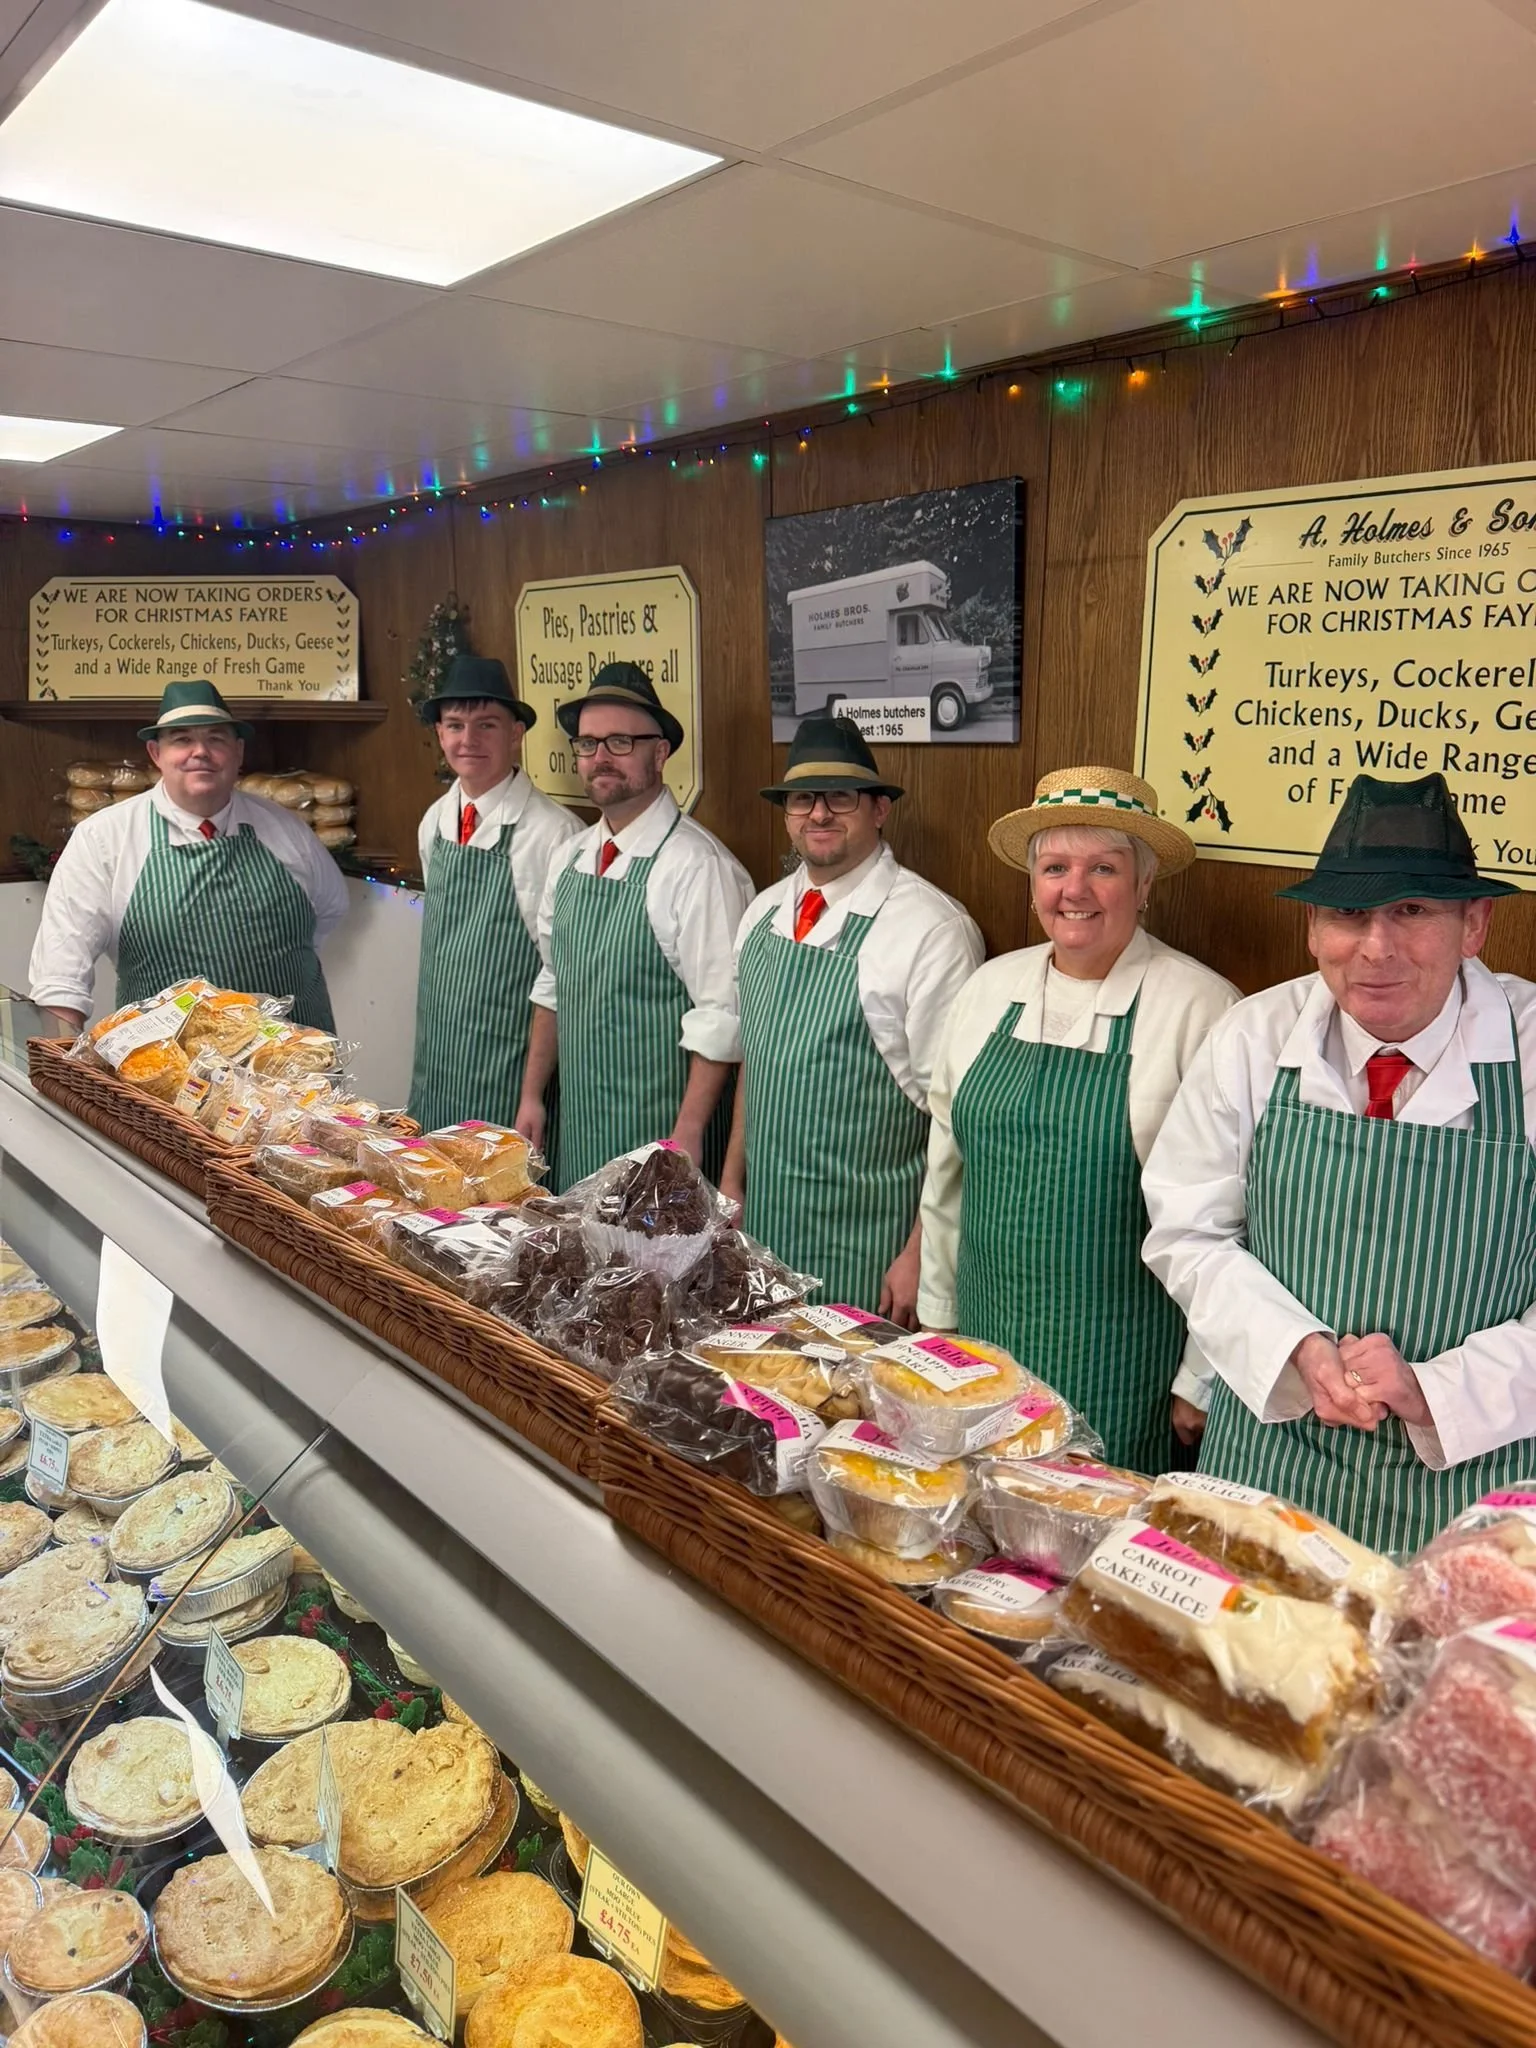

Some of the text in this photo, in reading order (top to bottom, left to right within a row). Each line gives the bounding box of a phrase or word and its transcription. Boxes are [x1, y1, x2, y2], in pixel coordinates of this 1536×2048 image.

[1299, 515, 1328, 549] A.
[1340, 508, 1435, 546] Holmes
[1448, 507, 1474, 538] &
[1328, 542, 1511, 568] Family Butchers Since 1965
[64, 586, 323, 603] WE ARE NOW TAKING ORDERS
[1227, 585, 1259, 607] WE
[1268, 582, 1313, 605] ARE
[1325, 577, 1389, 603] NOW
[1400, 571, 1505, 600] TAKING
[96, 607, 288, 623] FOR CHRISTMAS FAYRE
[543, 602, 659, 643] Pies, Pastries &
[808, 604, 871, 622] HOLMES BROS.
[813, 618, 864, 631] FAMILY BUTCHERS
[1267, 602, 1536, 635] FOR CHRISTMAS FAY
[51, 632, 334, 653] Turkeys, Cockerels, Chickens, Ducks, Geese
[74, 658, 305, 677] and a Wide Range of Fresh Game
[530, 653, 583, 690] Sausage
[661, 648, 679, 683] all
[1265, 661, 1379, 693] Turkeys,
[257, 680, 320, 691] Thank You
[837, 705, 926, 719] A Holmes butchers
[1234, 699, 1363, 731] Chickens,
[1377, 699, 1480, 734] Ducks,
[861, 725, 875, 737] est
[550, 751, 566, 774] on
[1268, 739, 1536, 780] and a Wide Range
[1288, 777, 1318, 803] of
[1493, 838, 1536, 866] You
[964, 1572, 1009, 1588] CHERRY
[1122, 1547, 1202, 1588] CARROT
[992, 1590, 1022, 1605] TART
[1095, 1555, 1209, 1619] CAKE SLICE
[599, 1908, 631, 1944] £4.75
[410, 1953, 433, 1990] £7.50
